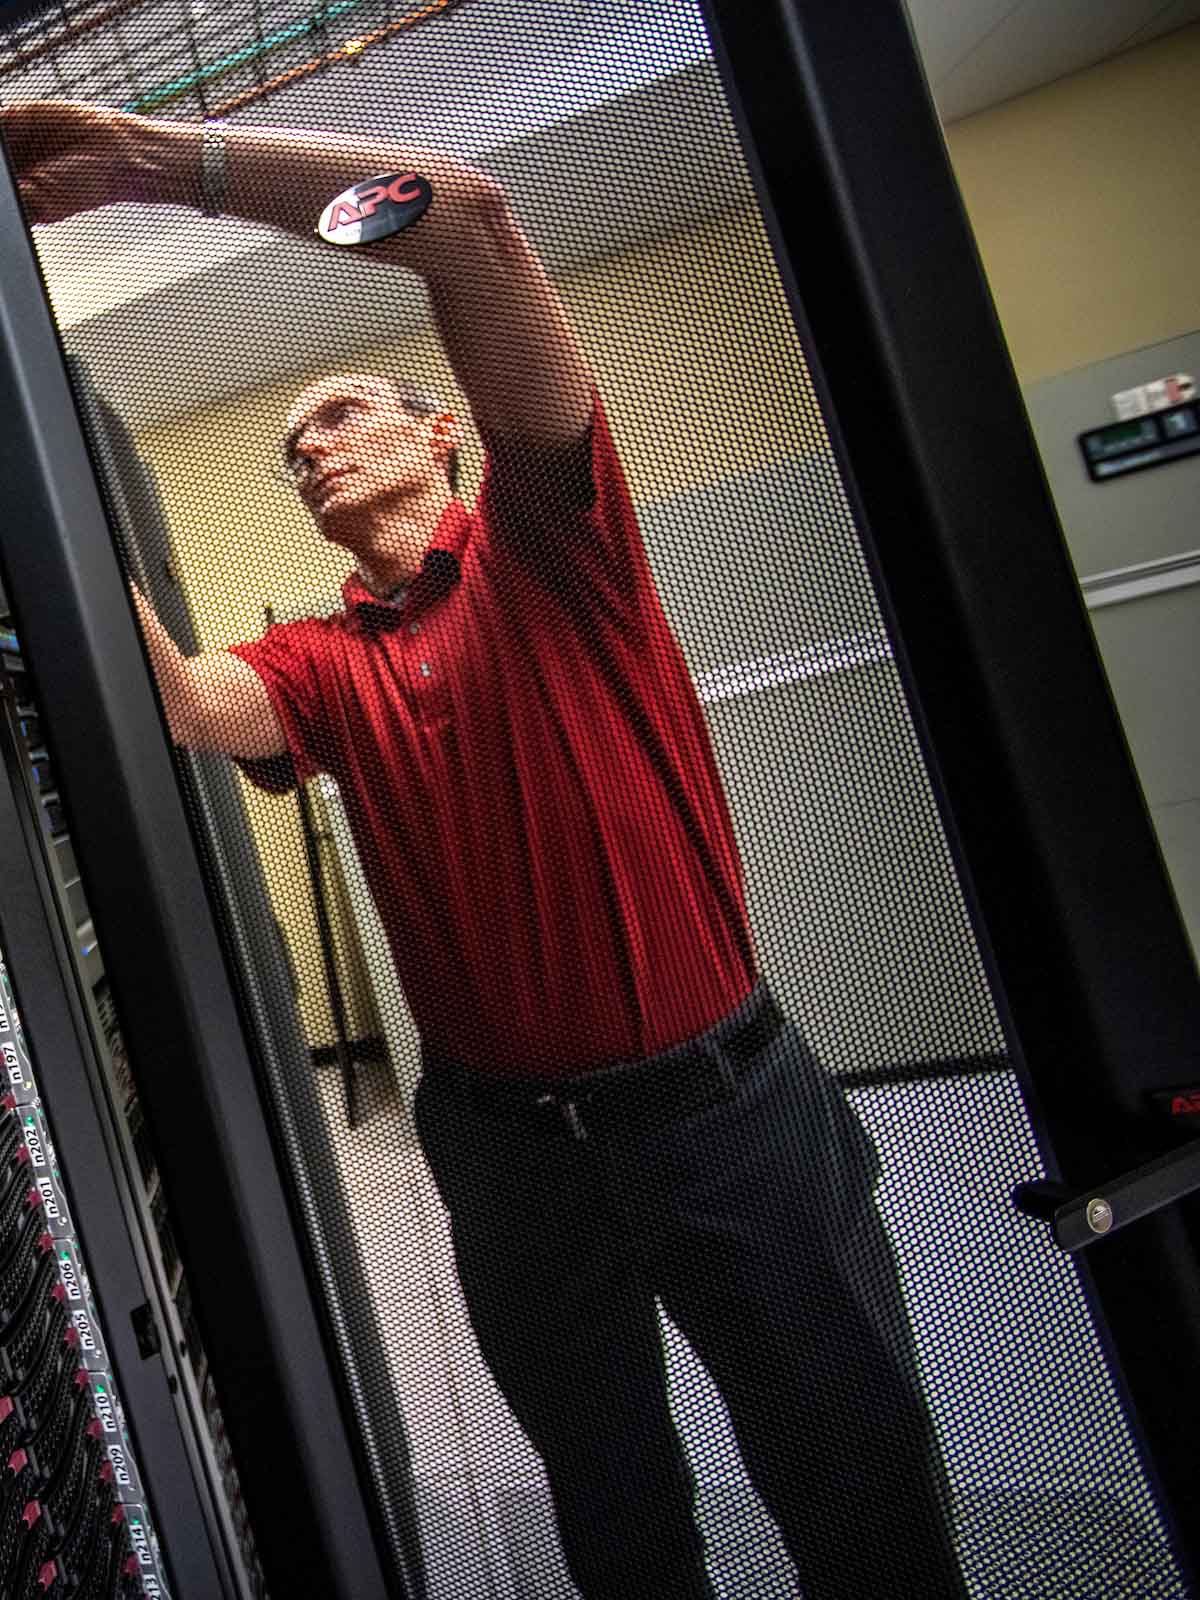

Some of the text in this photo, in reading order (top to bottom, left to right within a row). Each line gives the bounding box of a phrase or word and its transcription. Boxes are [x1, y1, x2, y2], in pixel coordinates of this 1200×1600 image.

[327, 172, 422, 232] APC
[4, 1046, 22, 1081] n197
[25, 1129, 44, 1163] n202
[40, 1181, 58, 1215] n201
[63, 1263, 80, 1297] n206
[77, 1313, 95, 1347] n205
[98, 1396, 115, 1430] n210
[111, 1448, 129, 1482] n209
[132, 1528, 151, 1561] n214
